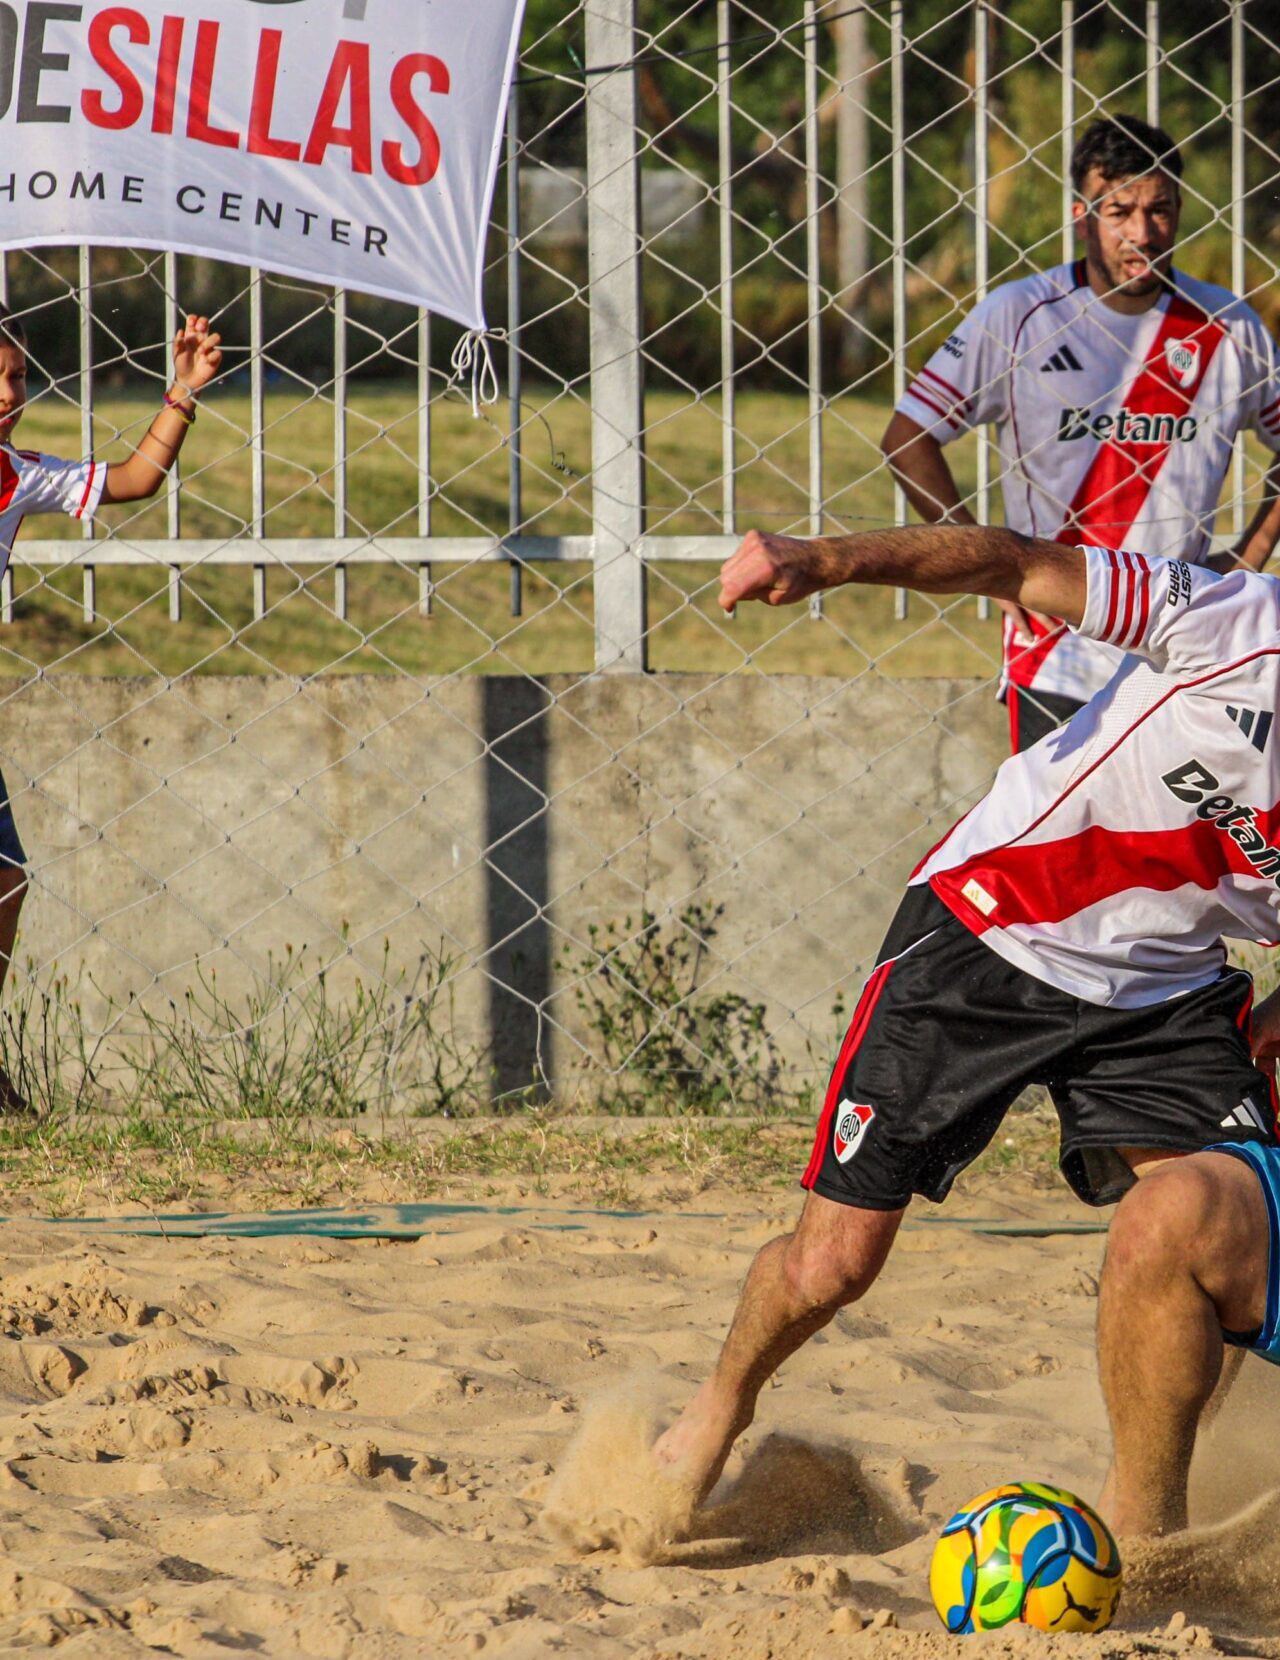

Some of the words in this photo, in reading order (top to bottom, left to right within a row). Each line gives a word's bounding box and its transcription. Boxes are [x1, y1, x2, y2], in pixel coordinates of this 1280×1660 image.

[0, 1, 450, 186] ESILLAS
[176, 185, 389, 257] CENTER
[1058, 407, 1198, 442] Betano
